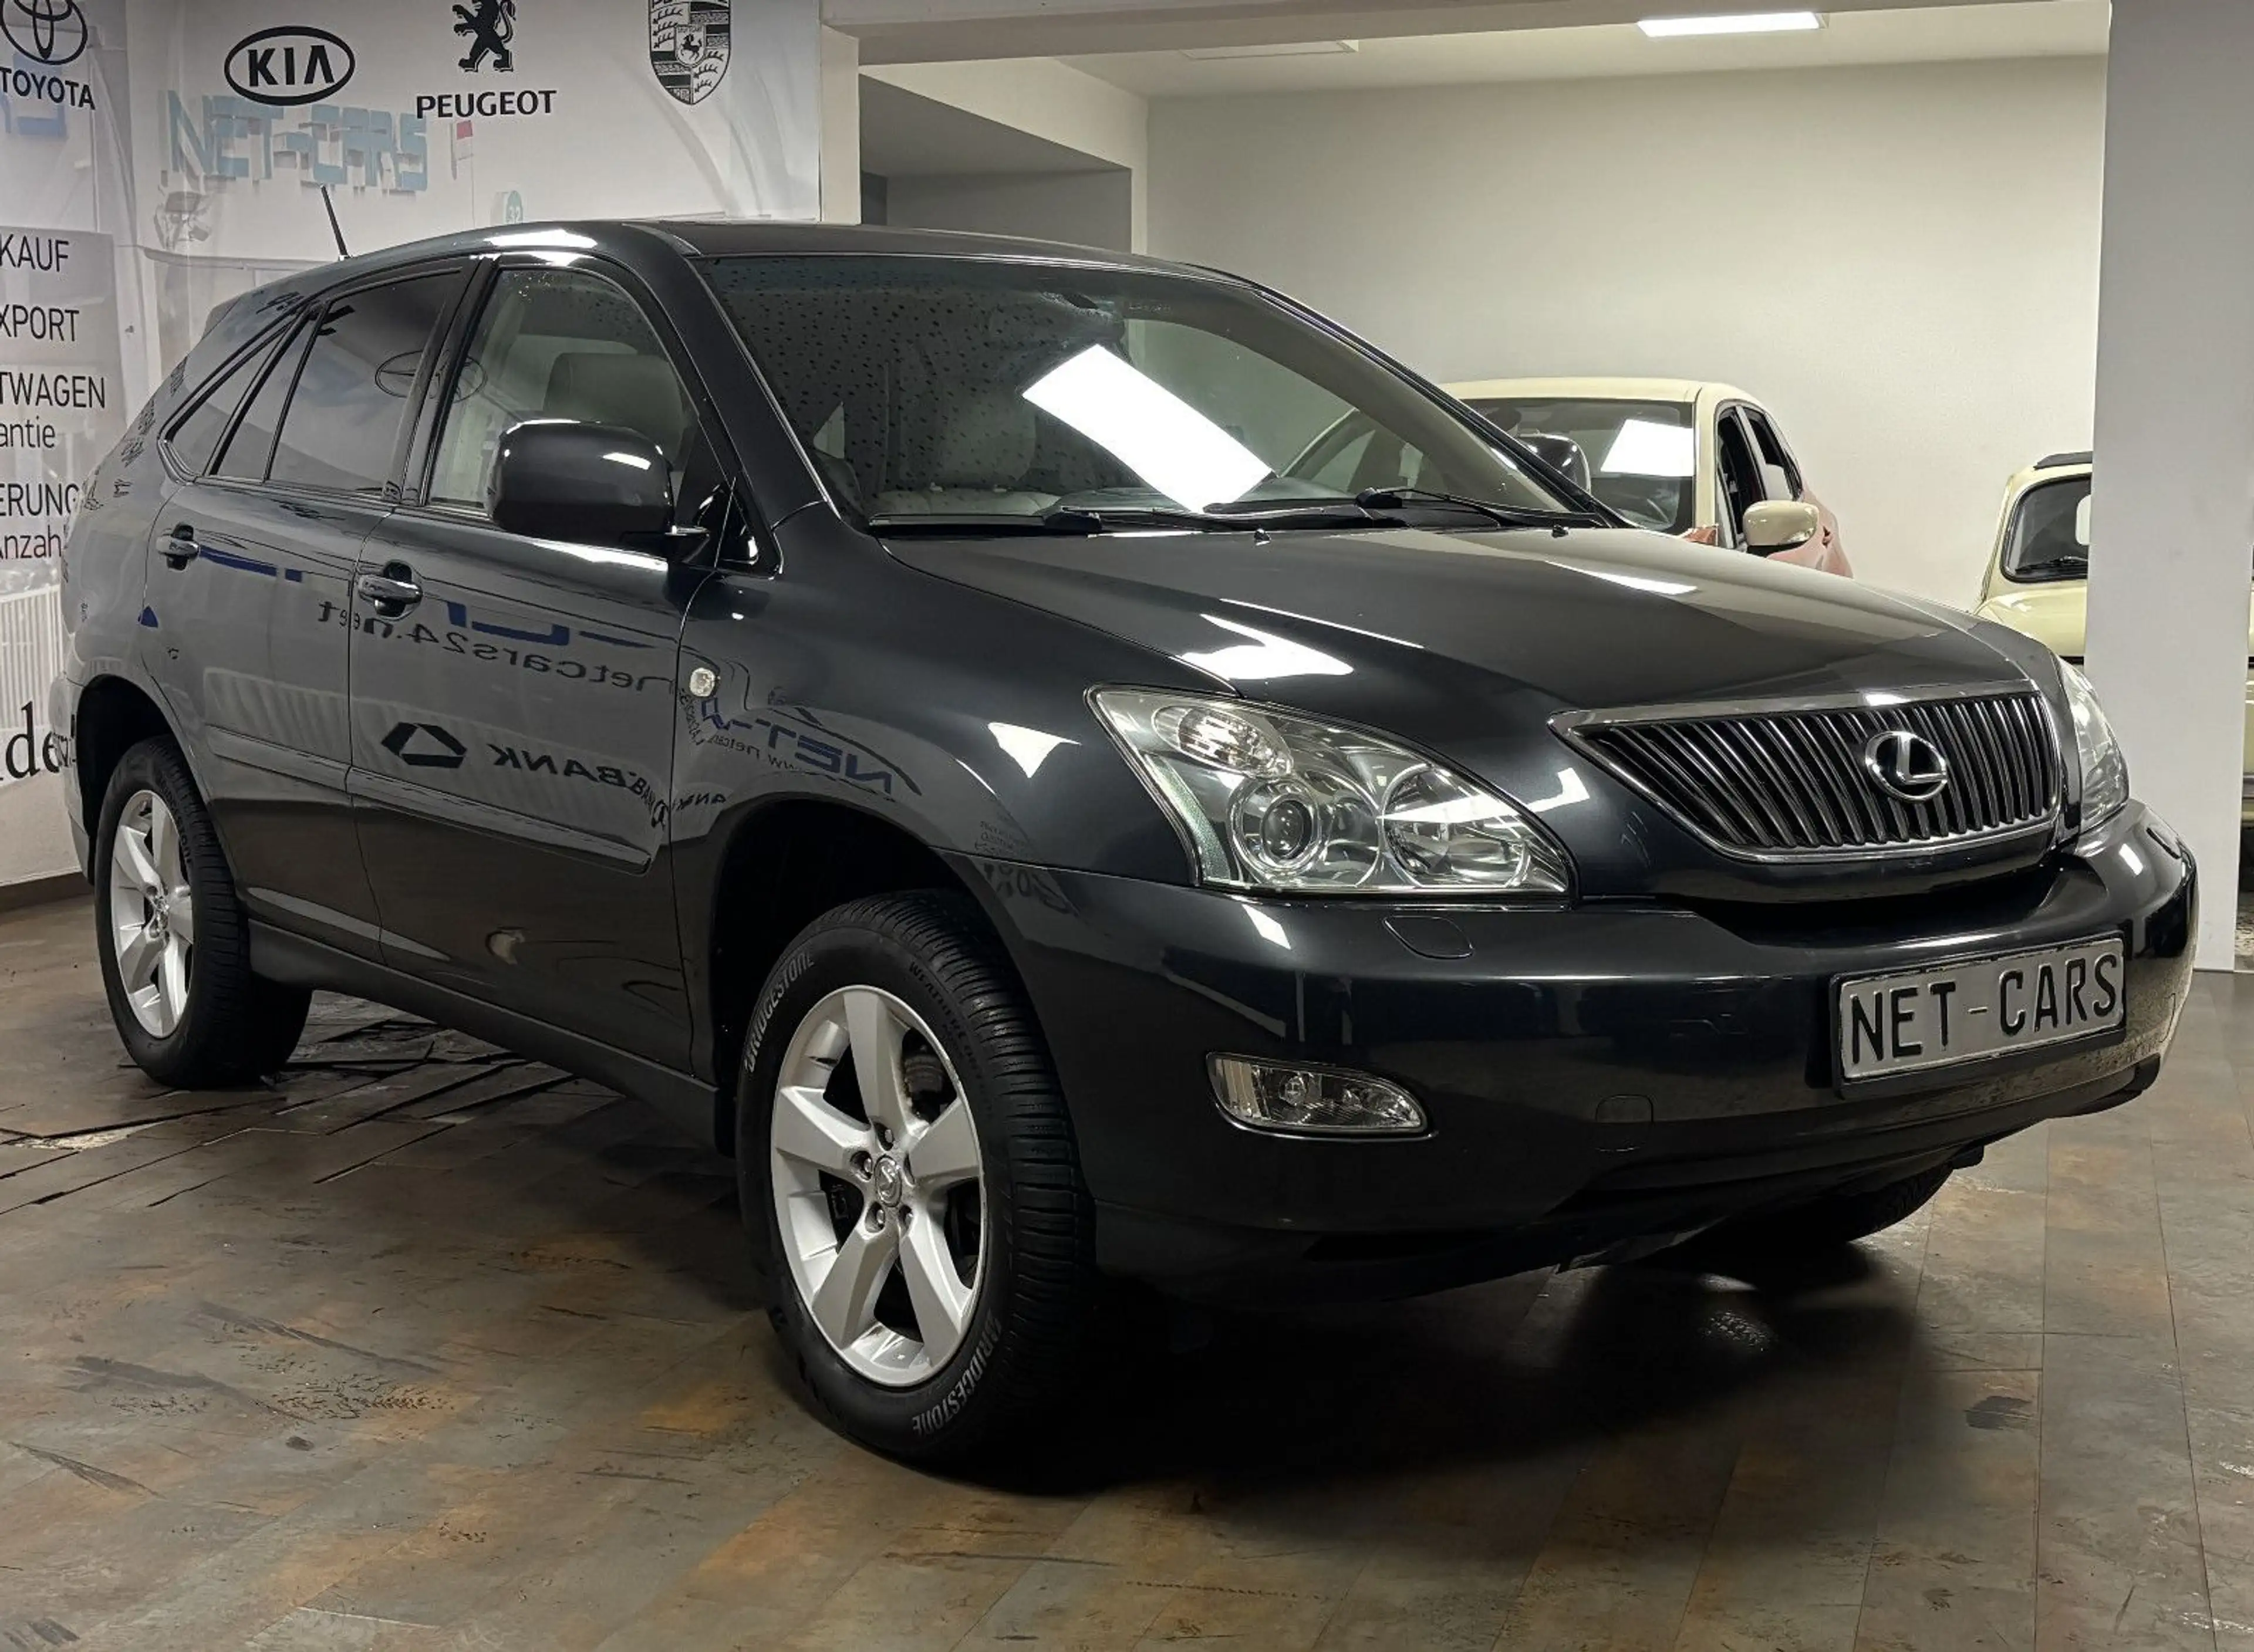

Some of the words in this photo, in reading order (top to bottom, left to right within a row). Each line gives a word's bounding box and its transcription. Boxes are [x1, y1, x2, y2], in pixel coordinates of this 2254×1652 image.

[248, 45, 335, 87] KIA
[0, 66, 95, 110] TOYOTA
[416, 90, 557, 119] PEUGEOT
